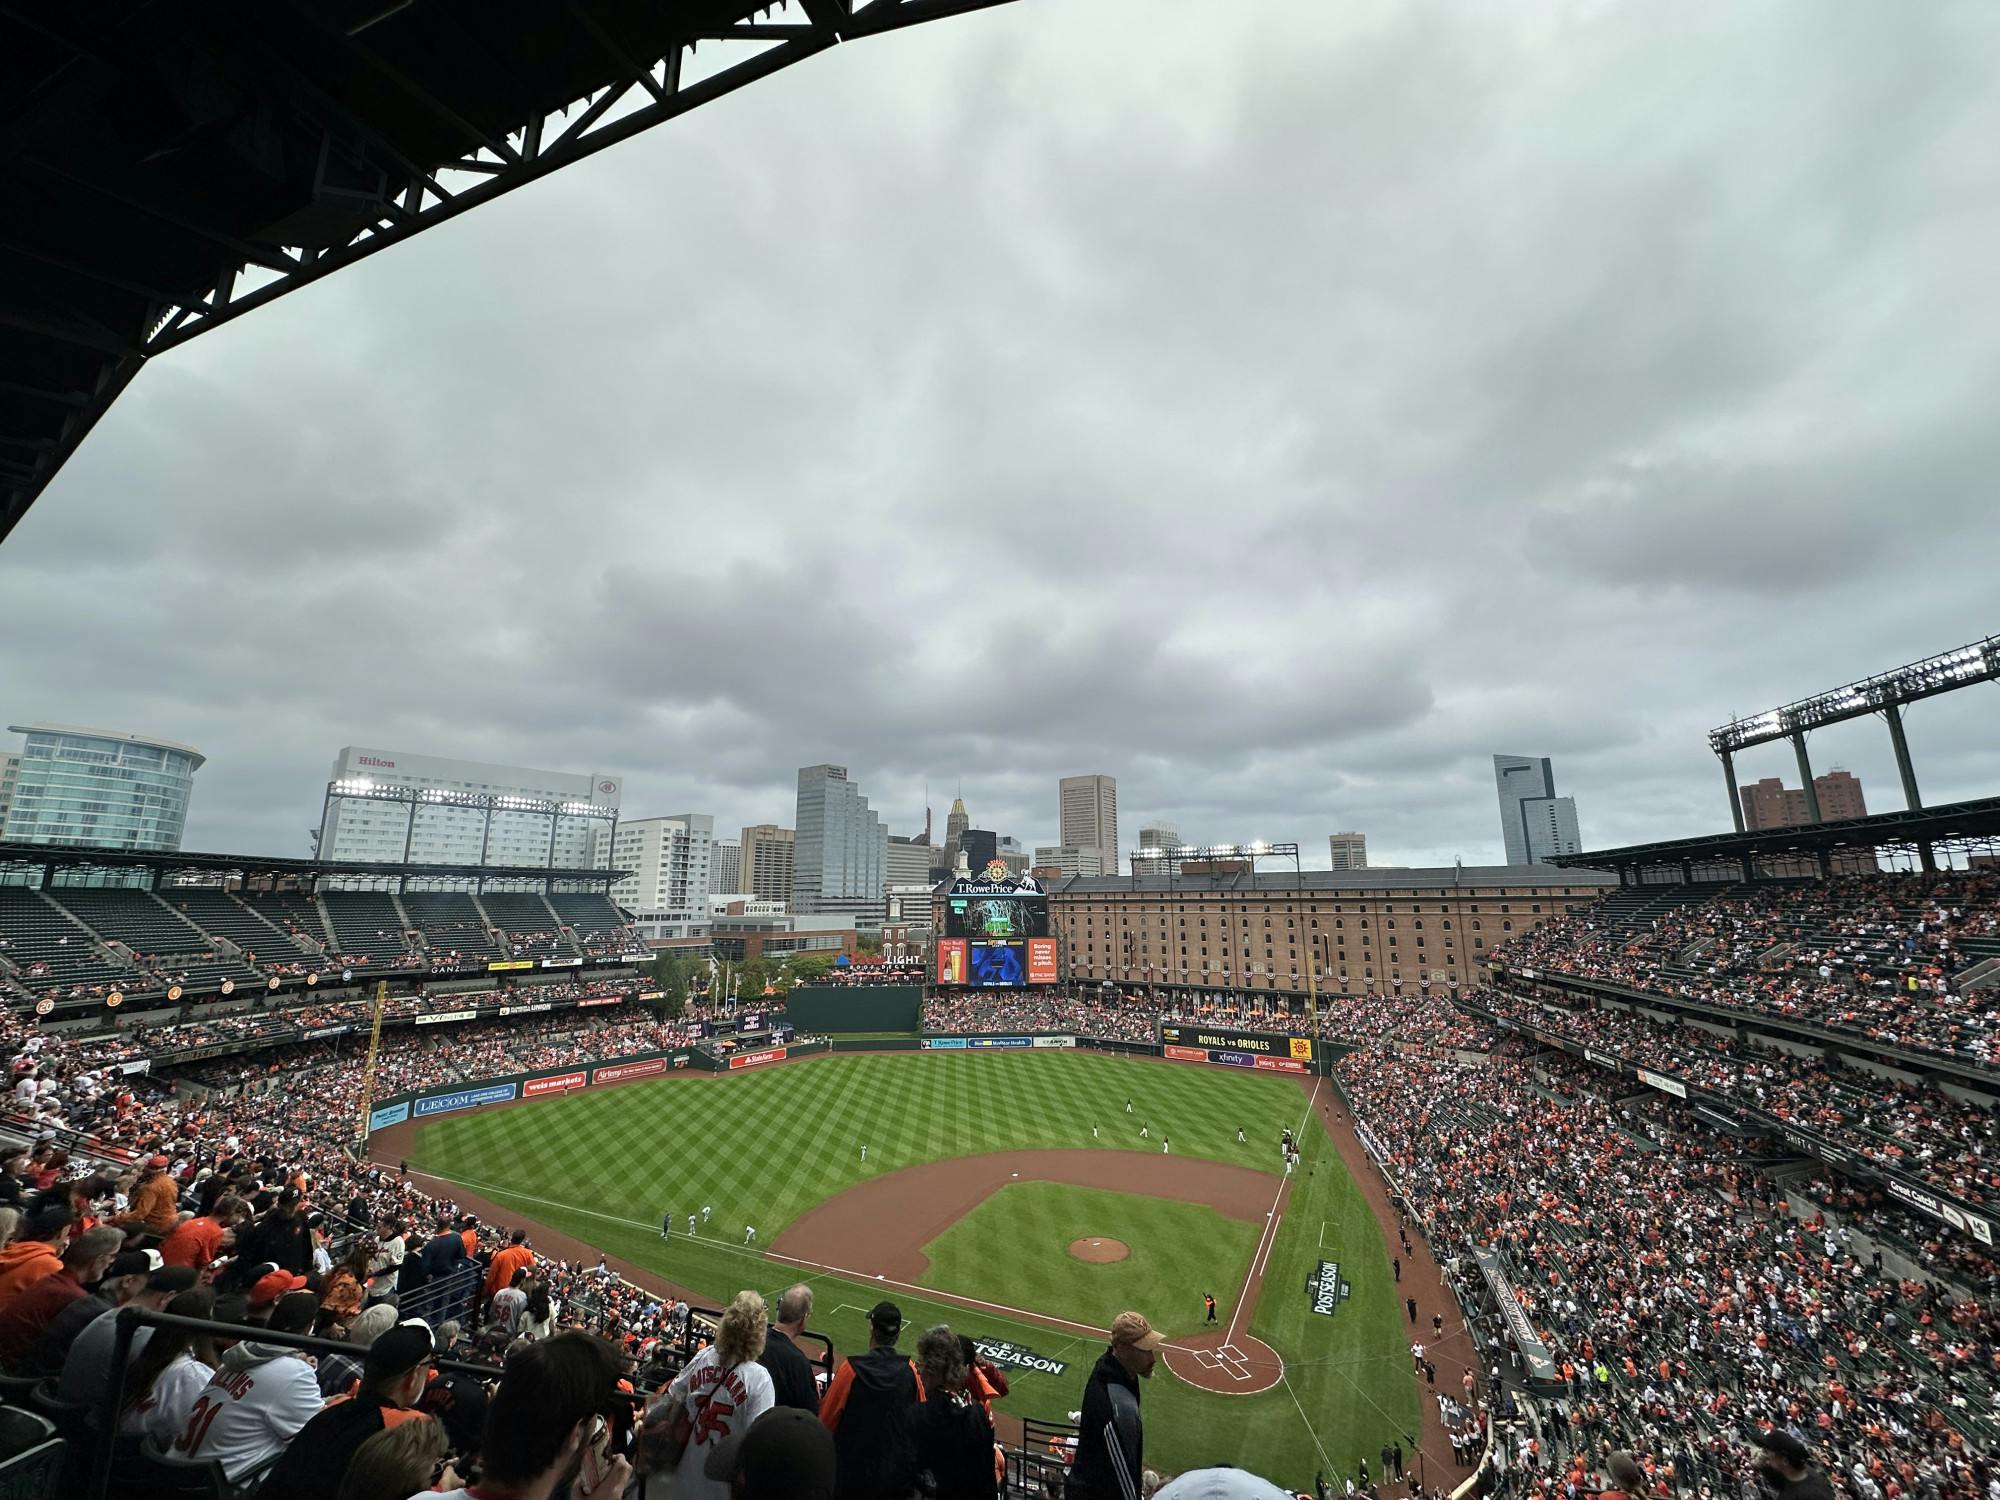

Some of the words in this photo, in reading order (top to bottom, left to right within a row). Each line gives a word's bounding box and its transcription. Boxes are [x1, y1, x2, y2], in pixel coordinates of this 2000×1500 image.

[358, 756, 395, 768] Hilton
[991, 884, 1013, 893] Price
[886, 955, 920, 965] LIGHT
[431, 961, 460, 974] GANZ
[40, 1001, 53, 1012] 20
[531, 1003, 552, 1011] UNION
[1198, 1035, 1226, 1046] ROYALS
[1237, 1039, 1270, 1051] ORIOLES
[1218, 1053, 1243, 1064] xfinity
[528, 1082, 548, 1091] weis
[548, 1076, 582, 1088] markets
[1890, 1180, 1911, 1197] Great
[1911, 1190, 1938, 1209] Catch!
[1314, 1261, 1338, 1315] POSTSEASON
[972, 1341, 1064, 1375] TSEASON
[174, 1395, 223, 1459] 31
